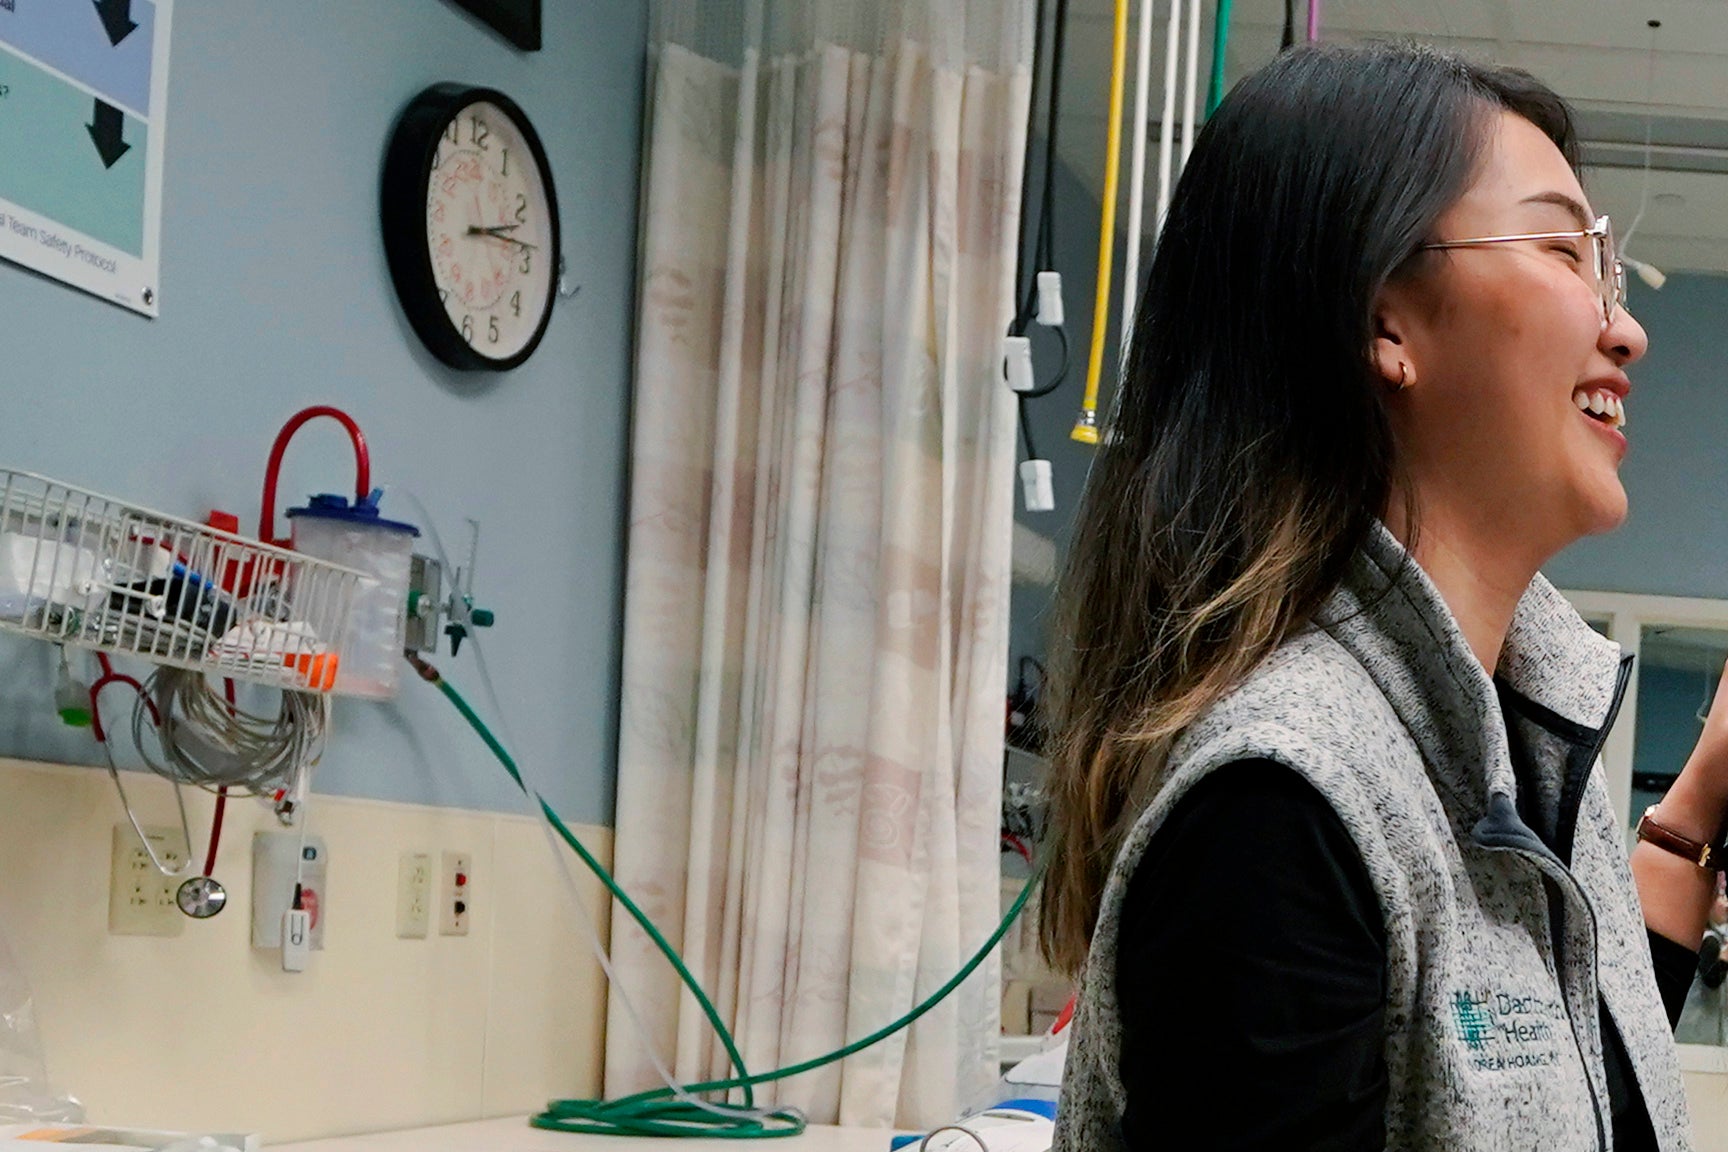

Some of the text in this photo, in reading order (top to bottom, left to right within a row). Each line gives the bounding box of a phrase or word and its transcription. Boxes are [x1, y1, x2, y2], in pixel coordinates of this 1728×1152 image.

[471, 116, 489, 151] 12
[501, 147, 508, 177] 1
[515, 193, 526, 224] 2
[7, 214, 38, 241] Team
[39, 230, 72, 258] Safety
[74, 244, 118, 273] Protocol
[518, 245, 530, 274] 3
[510, 290, 521, 317] 4
[462, 314, 473, 344] 6
[488, 314, 499, 344] 5
[1496, 993, 1566, 1020] Dartth
